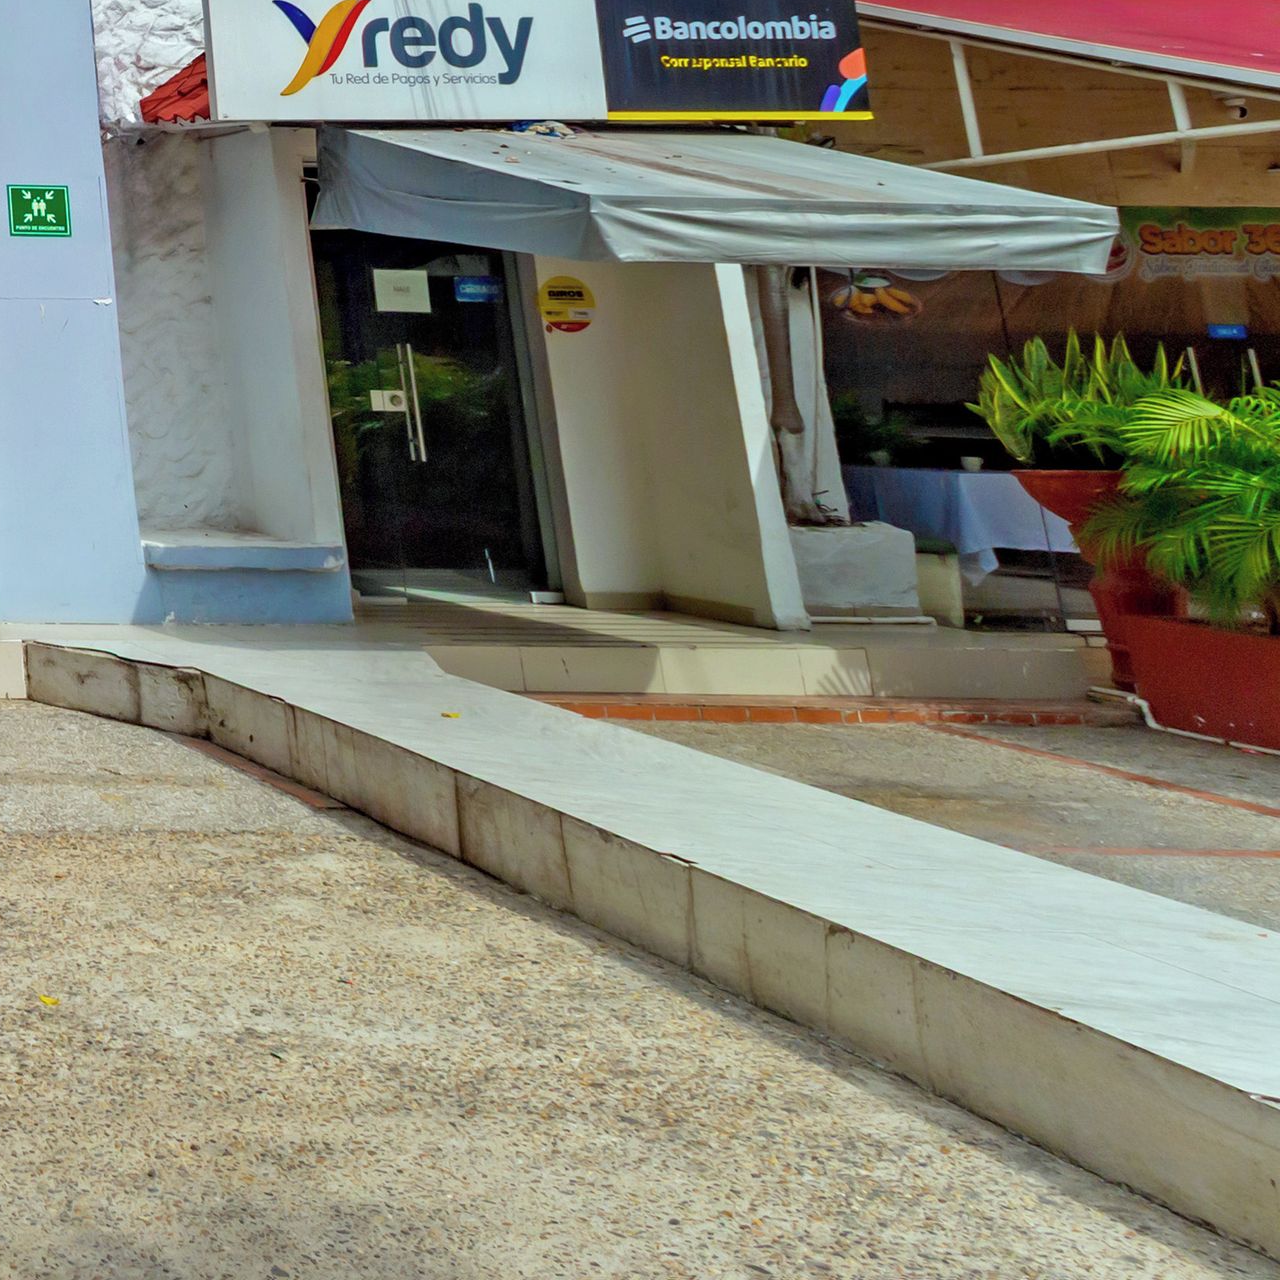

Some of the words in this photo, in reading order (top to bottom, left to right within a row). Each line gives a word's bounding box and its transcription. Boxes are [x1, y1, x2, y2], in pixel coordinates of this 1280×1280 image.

[653, 14, 836, 40] Bancolombia
[330, 73, 343, 85] Tu
[346, 73, 370, 85] Red
[372, 73, 389, 85] de
[392, 73, 430, 88] Pagos
[434, 76, 440, 87] y
[443, 73, 497, 85] Servicios
[1139, 223, 1237, 255] Sabor
